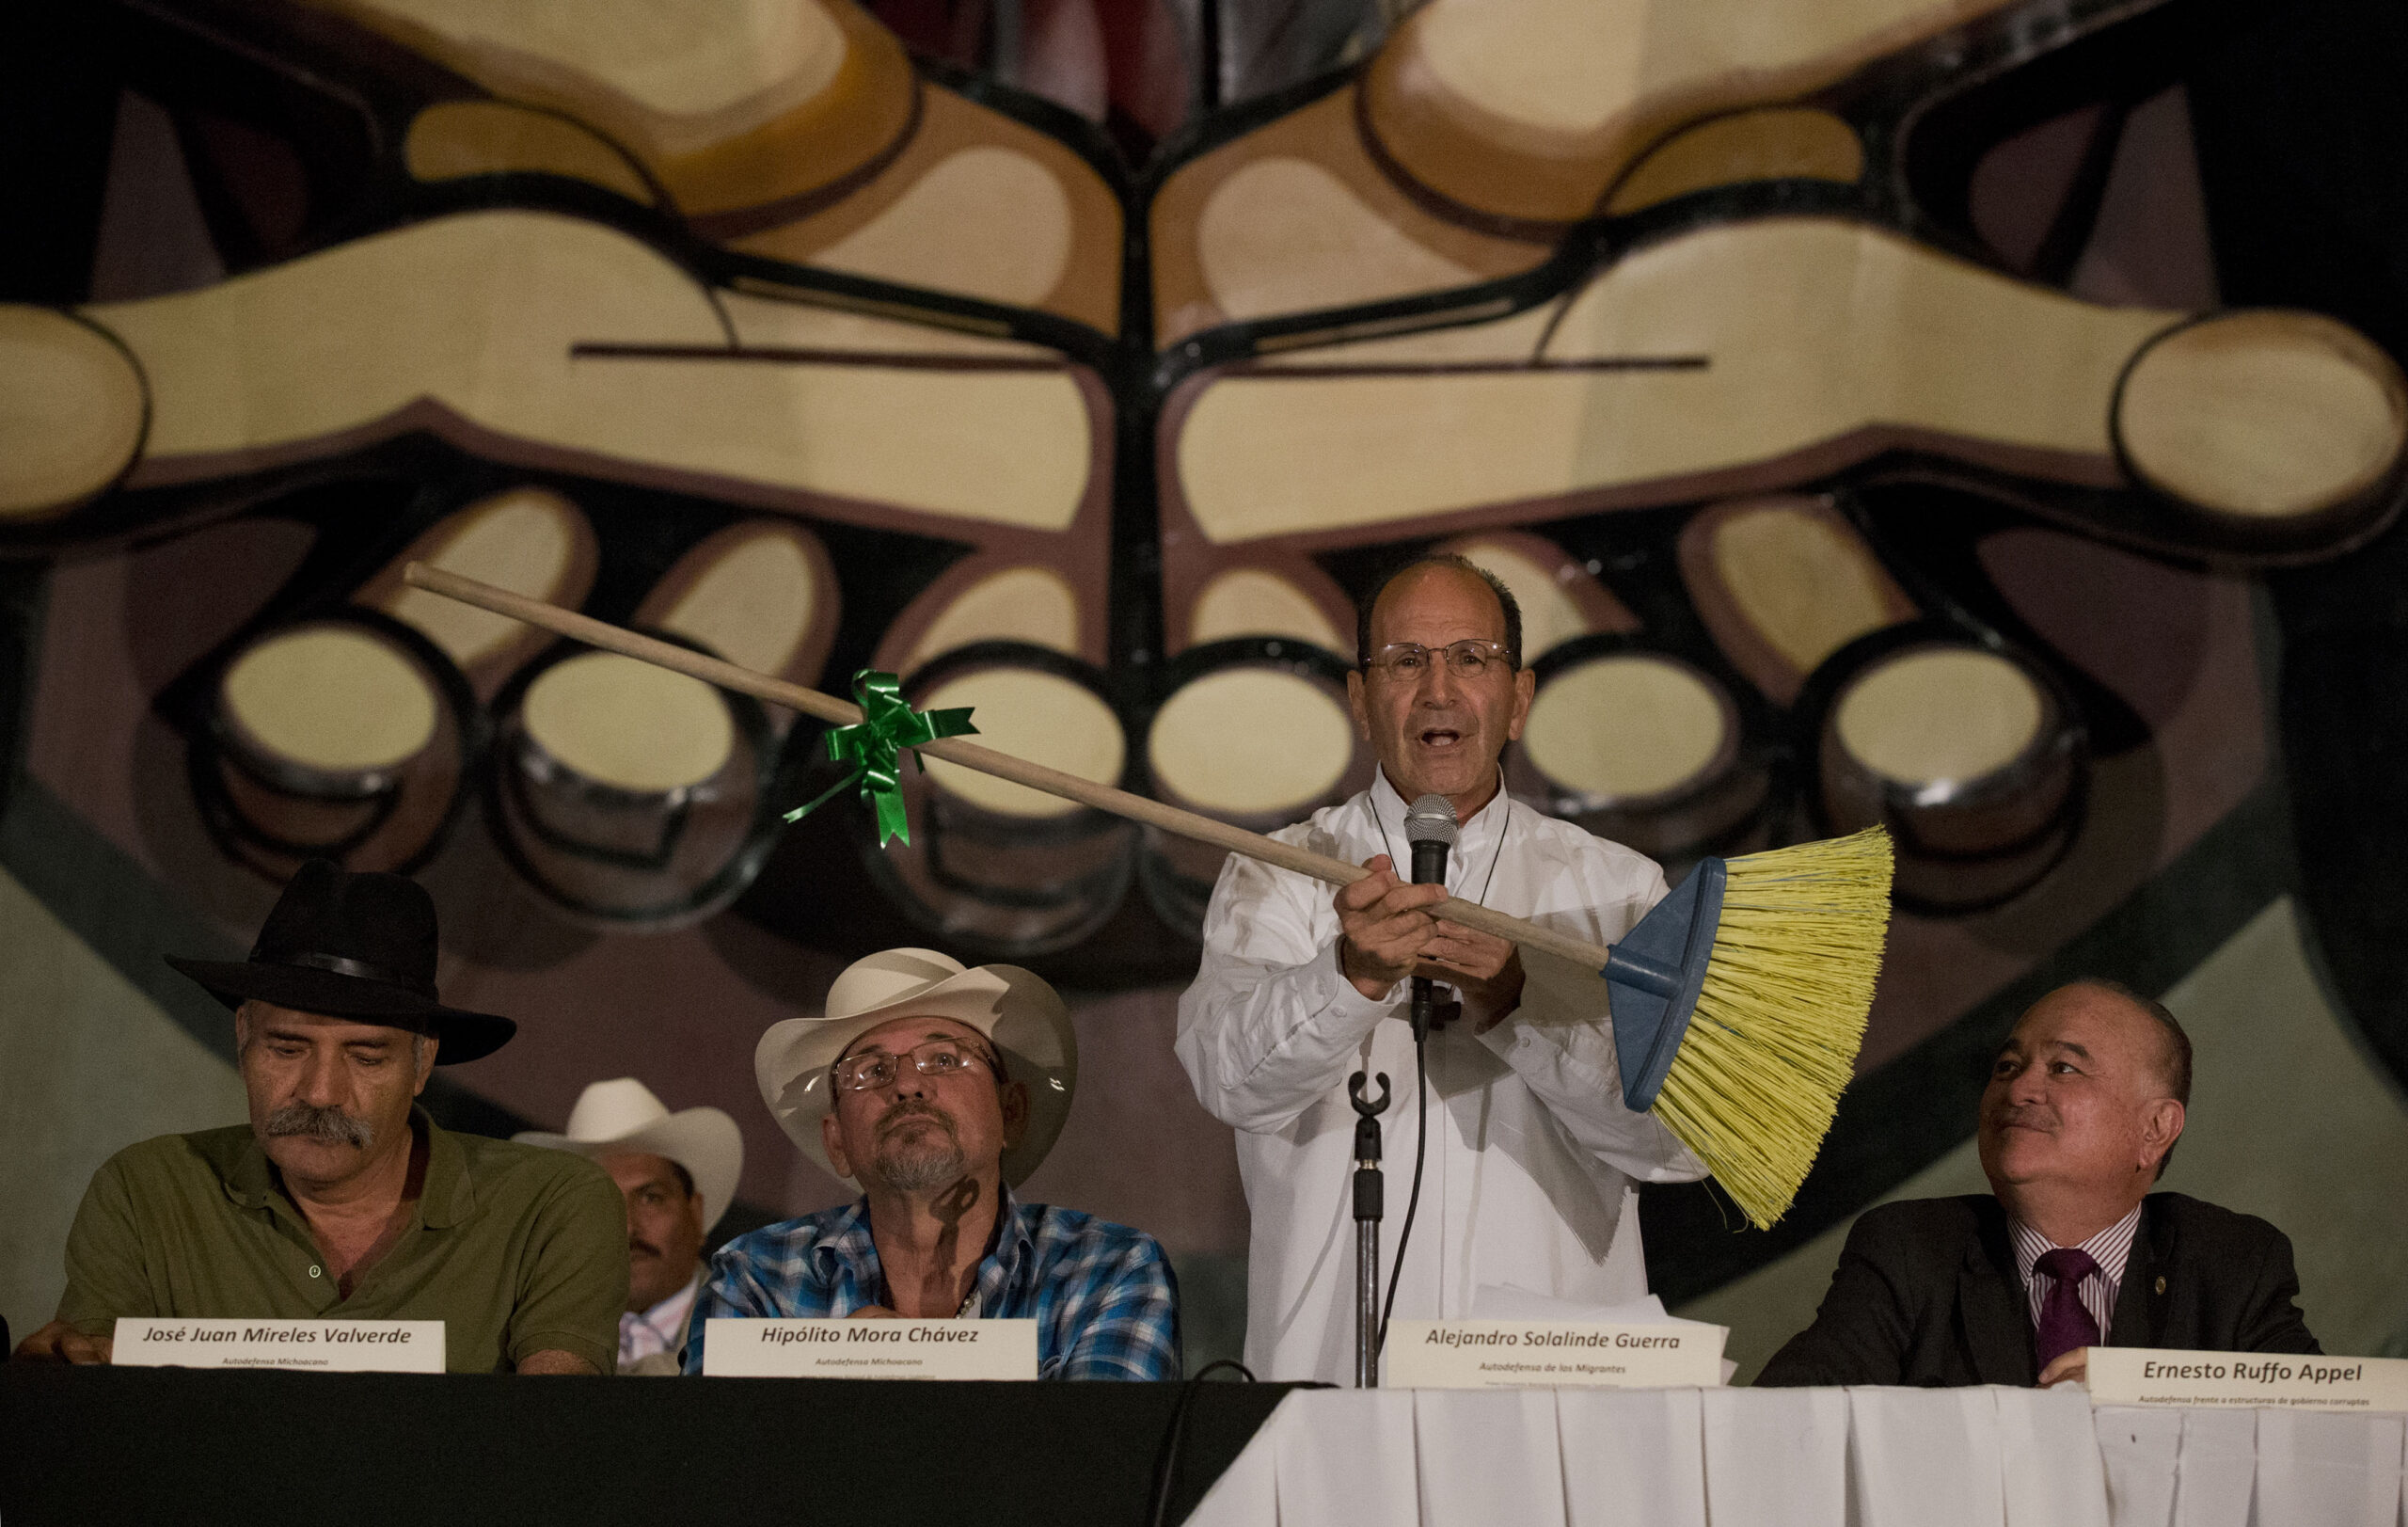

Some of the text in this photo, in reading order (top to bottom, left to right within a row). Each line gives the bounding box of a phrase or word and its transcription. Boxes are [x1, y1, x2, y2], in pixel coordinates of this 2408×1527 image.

[143, 1327, 412, 1344] José Juan Mireles Valverde
[761, 1327, 979, 1345] Hipólito Mora Chávez
[1425, 1328, 1681, 1349] Alejandro Solalinde Guerra
[222, 1358, 276, 1367] Autodefensa
[815, 1358, 869, 1367] Autodefensa
[1479, 1362, 1542, 1374] Autodefensa
[1544, 1363, 1557, 1372] de
[1576, 1364, 1625, 1376] Migrantes
[2144, 1361, 2362, 1385] Ernesto Ruffo Appel
[2138, 1395, 2192, 1405] Autodefensa
[2193, 1396, 2219, 1405] frente
